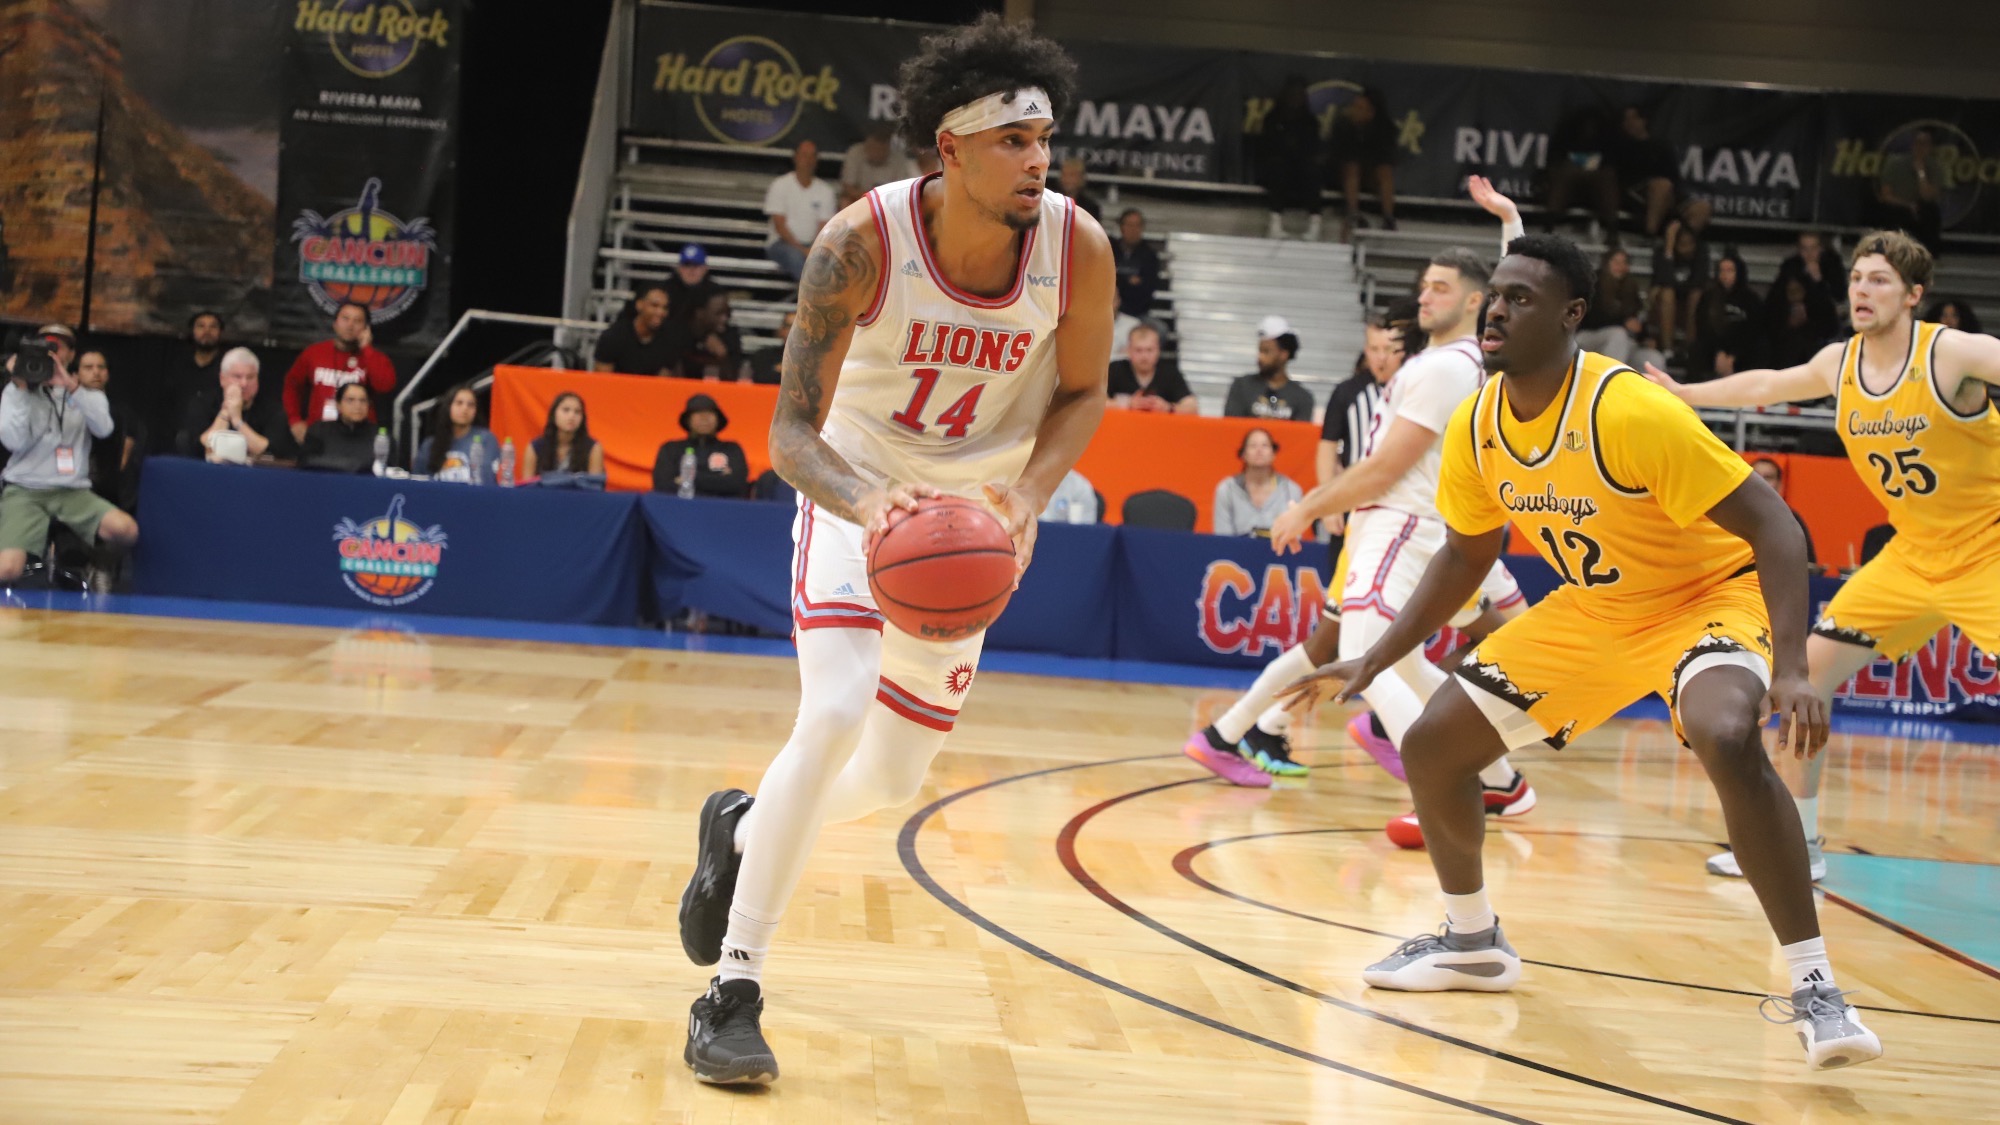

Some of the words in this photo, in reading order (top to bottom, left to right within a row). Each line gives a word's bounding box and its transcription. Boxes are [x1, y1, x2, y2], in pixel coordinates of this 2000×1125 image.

[294, 0, 375, 34] Hard
[376, 5, 450, 47] Rock
[654, 53, 749, 95] Hard
[751, 60, 841, 111] Rock
[1074, 100, 1215, 143] MAYA
[1454, 126, 1549, 169] RIVI
[310, 264, 416, 284] CHALLENGE
[1027, 273, 1059, 288] WCC
[900, 319, 1034, 374] LIONS
[891, 368, 987, 438] 14
[1848, 409, 1931, 441] Cowboys
[1868, 447, 1938, 499] 25
[1498, 481, 1600, 525] Cowboys
[345, 559, 431, 577] CHALLENGE
[1539, 525, 1622, 588] 12
